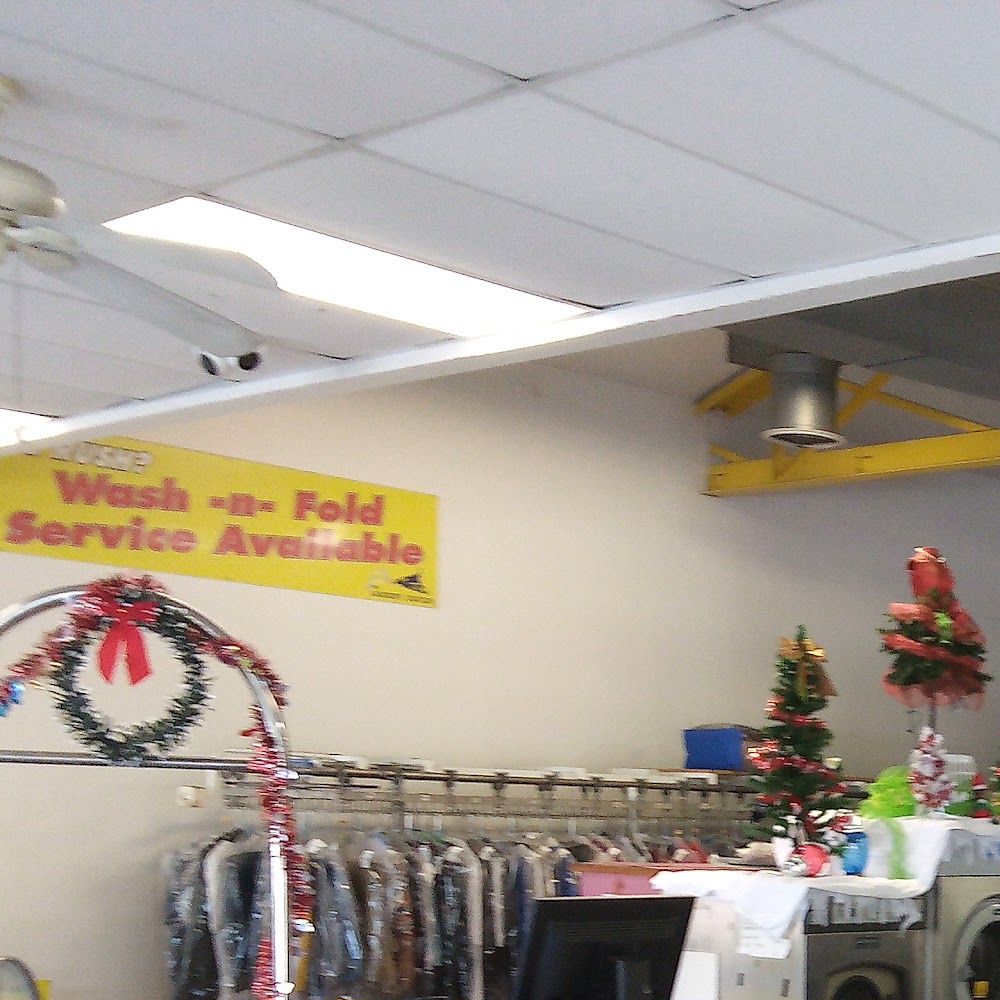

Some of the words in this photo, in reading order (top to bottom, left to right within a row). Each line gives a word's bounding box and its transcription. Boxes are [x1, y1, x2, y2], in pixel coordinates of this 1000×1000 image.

[53, 470, 191, 514] Wash
[293, 490, 387, 528] Fold
[5, 510, 199, 555] Service
[213, 522, 426, 567] Available
